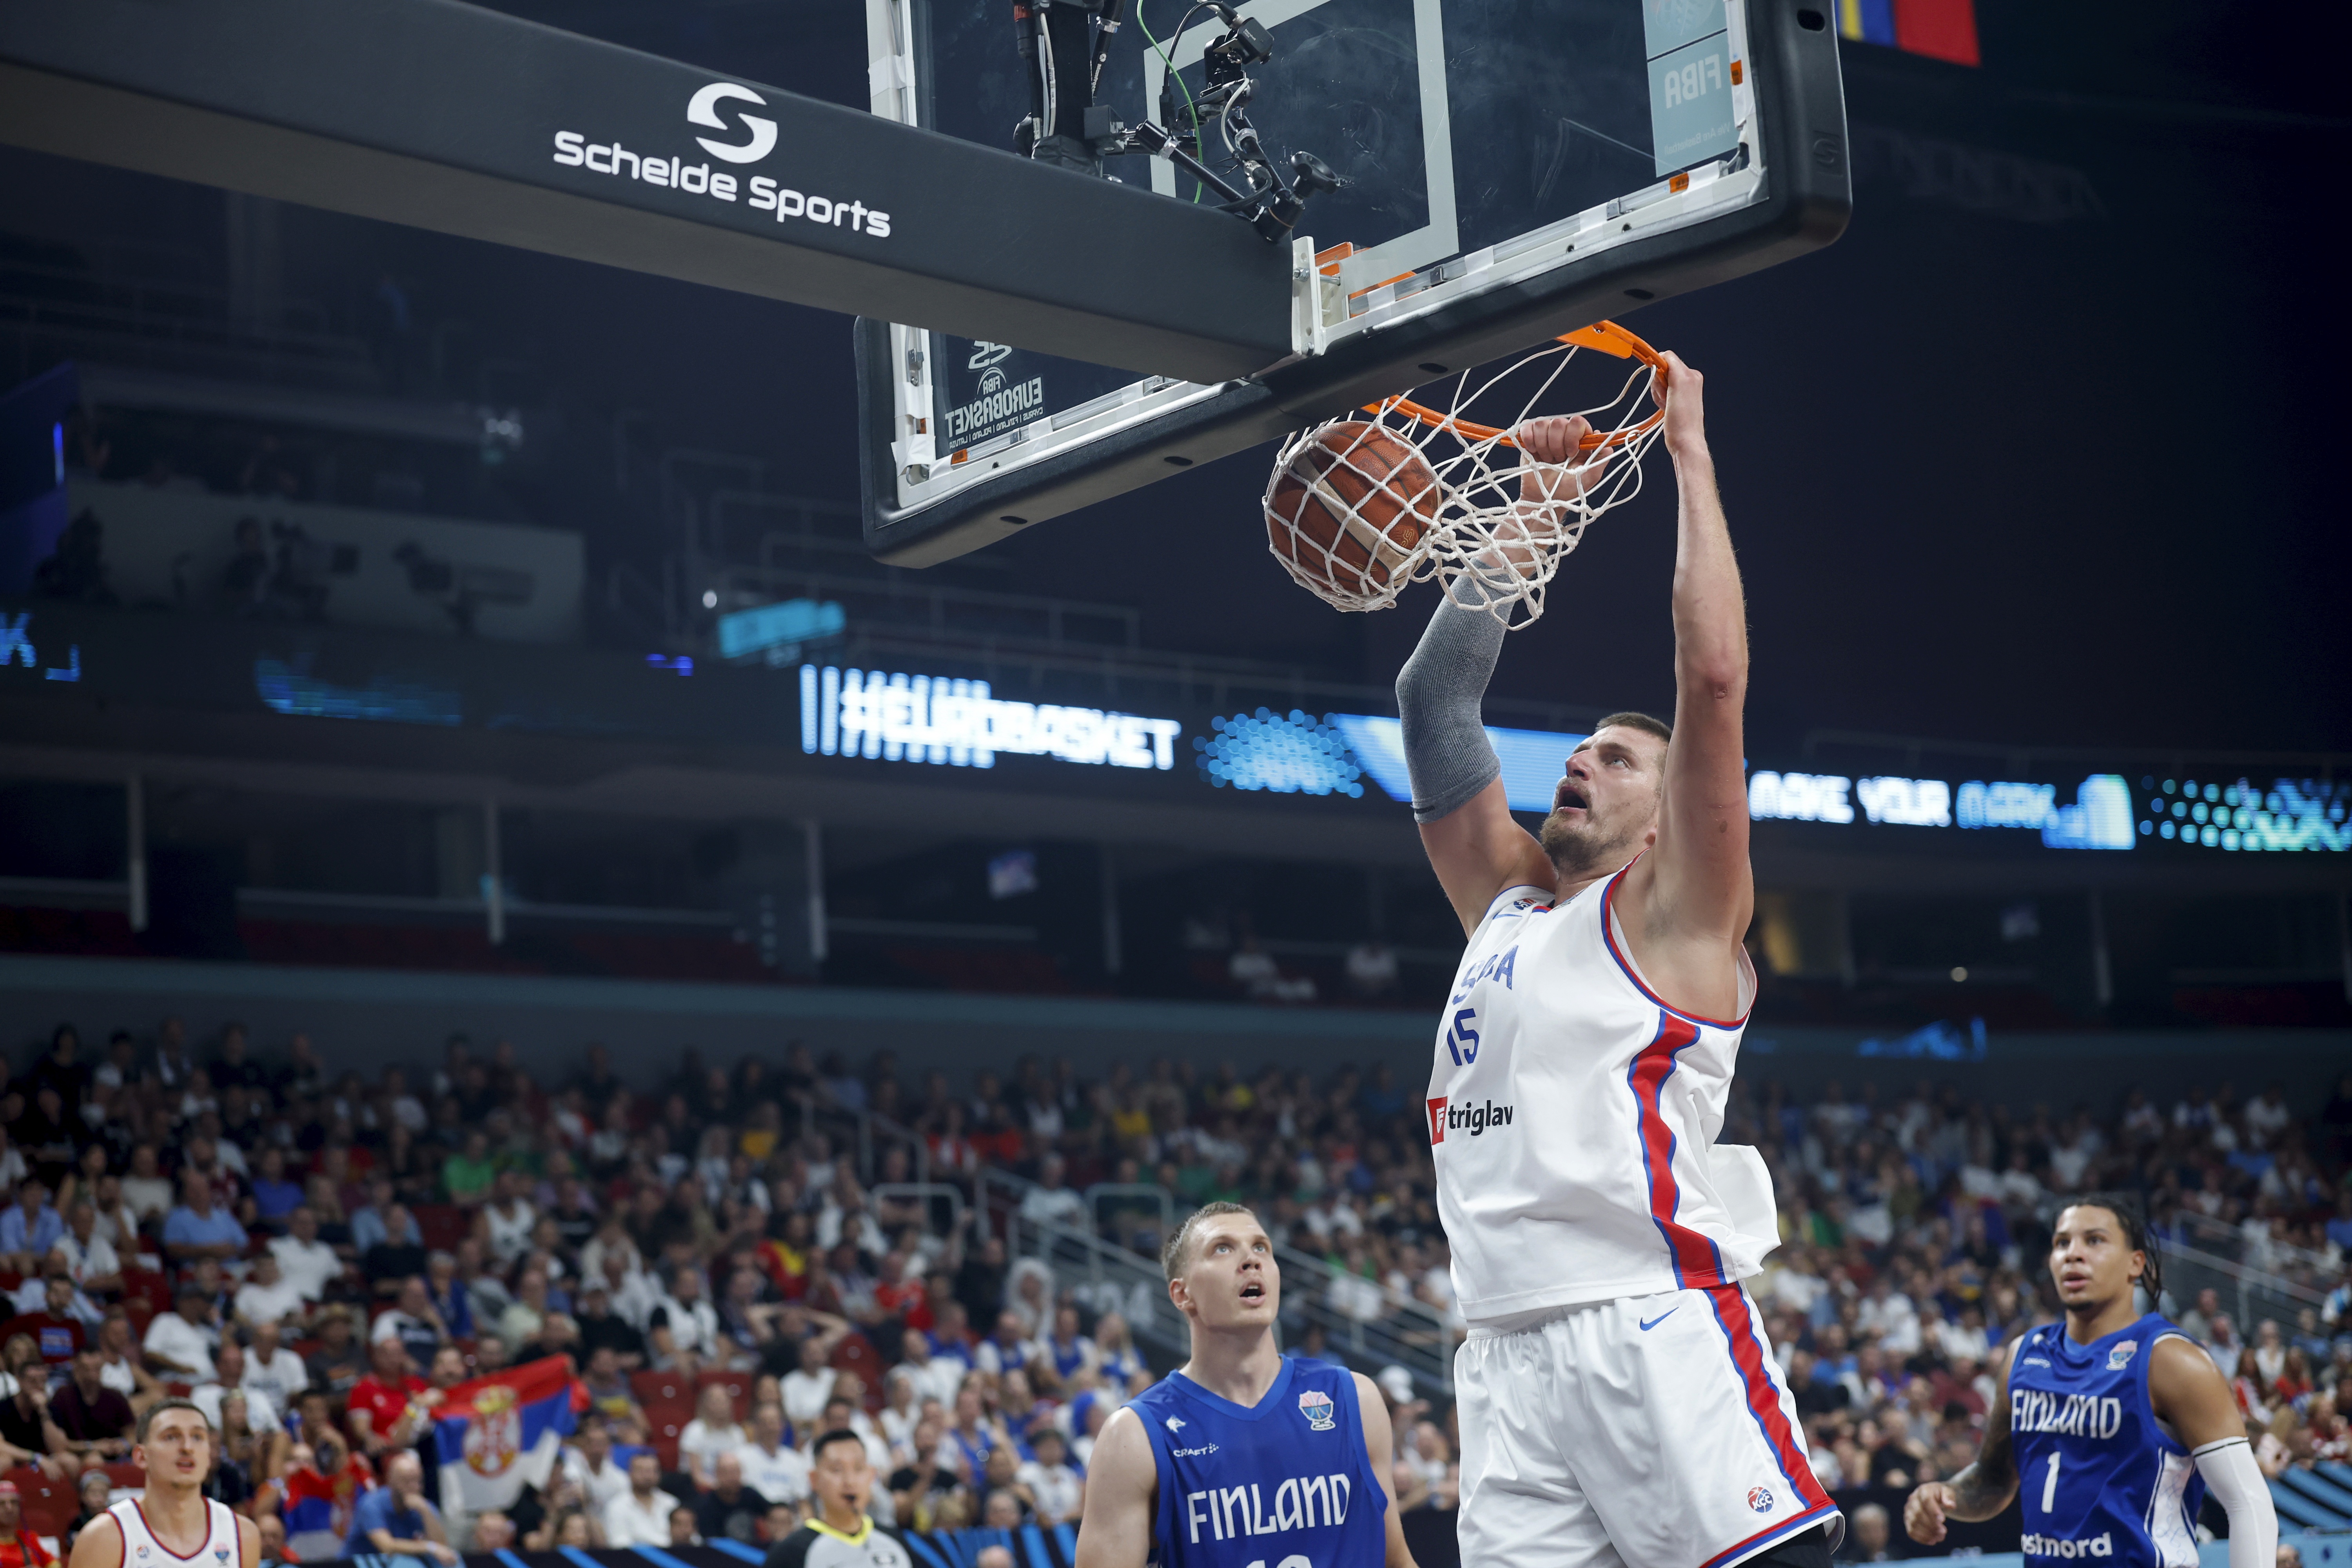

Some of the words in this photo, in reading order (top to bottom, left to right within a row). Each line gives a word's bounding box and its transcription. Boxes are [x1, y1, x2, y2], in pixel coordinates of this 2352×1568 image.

[553, 130, 737, 202] Schelde
[748, 175, 891, 238] Sports
[1857, 777, 1951, 826] YOUR
[1446, 1008, 1479, 1066] 15
[1448, 1099, 1512, 1136] triglav
[2011, 1389, 2122, 1440] FINLAND
[1173, 1446, 1208, 1457] CRAFT
[1187, 1473, 1350, 1544] FINLAND
[2041, 1451, 2061, 1514] 1
